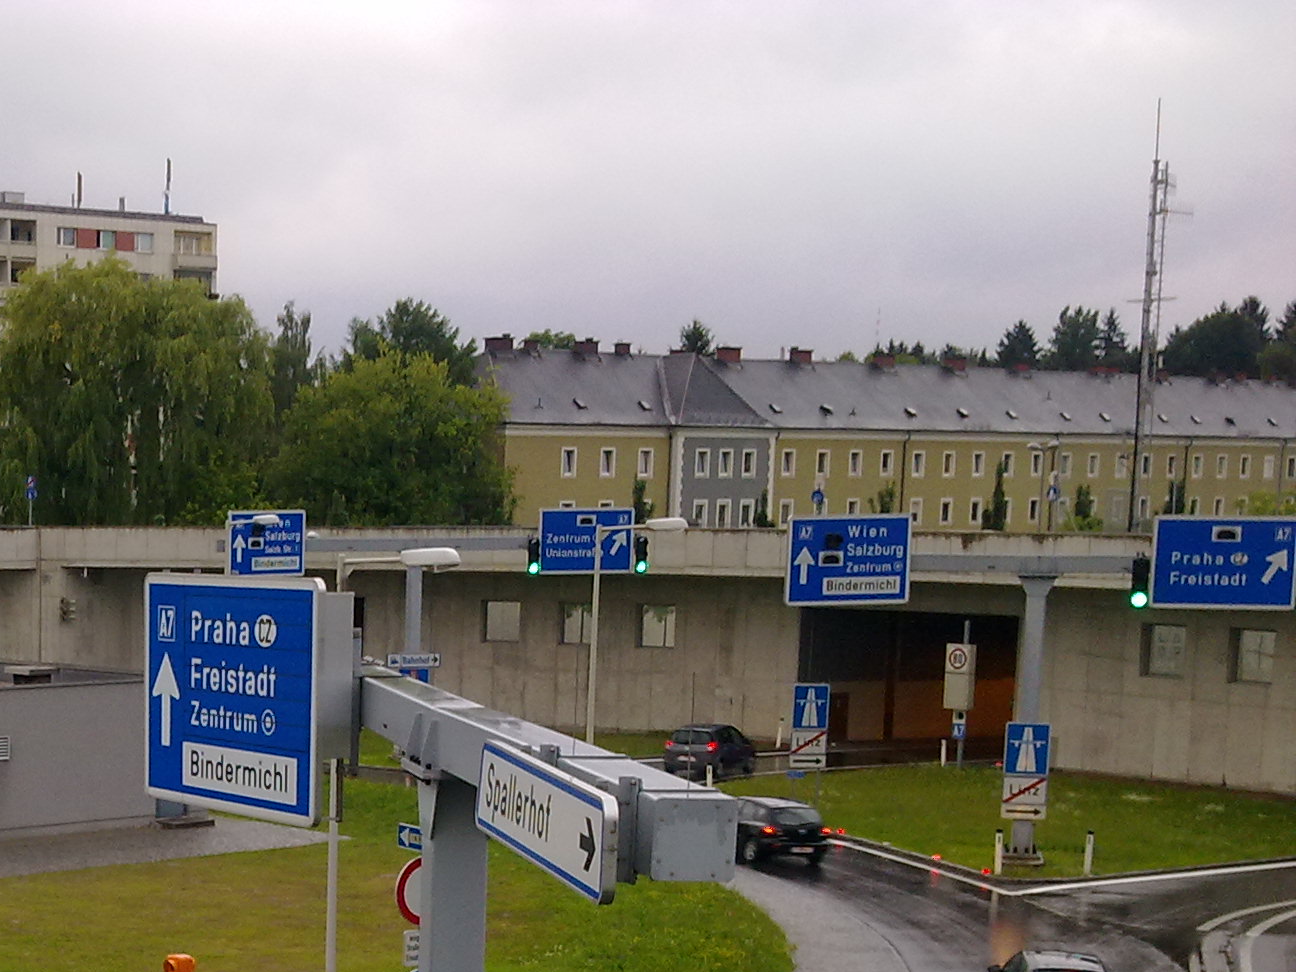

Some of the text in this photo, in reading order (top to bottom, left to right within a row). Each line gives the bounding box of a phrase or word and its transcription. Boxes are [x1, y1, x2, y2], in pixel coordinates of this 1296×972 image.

[265, 531, 301, 543] Salzburg
[546, 533, 590, 543] Zentrum
[848, 525, 888, 538] Wien
[847, 543, 904, 558] Salzburg
[1171, 551, 1224, 565] Praha
[846, 562, 892, 573] Zentrum
[826, 580, 897, 592] Bindermichl
[1169, 571, 1247, 586] Freistadt
[159, 609, 175, 639] A7
[191, 610, 272, 646] Praha CZ
[190, 657, 277, 698] Freistadt
[190, 701, 258, 734] Zentrum
[190, 750, 288, 793] Bindermichl
[486, 763, 551, 842] Spallerhof
